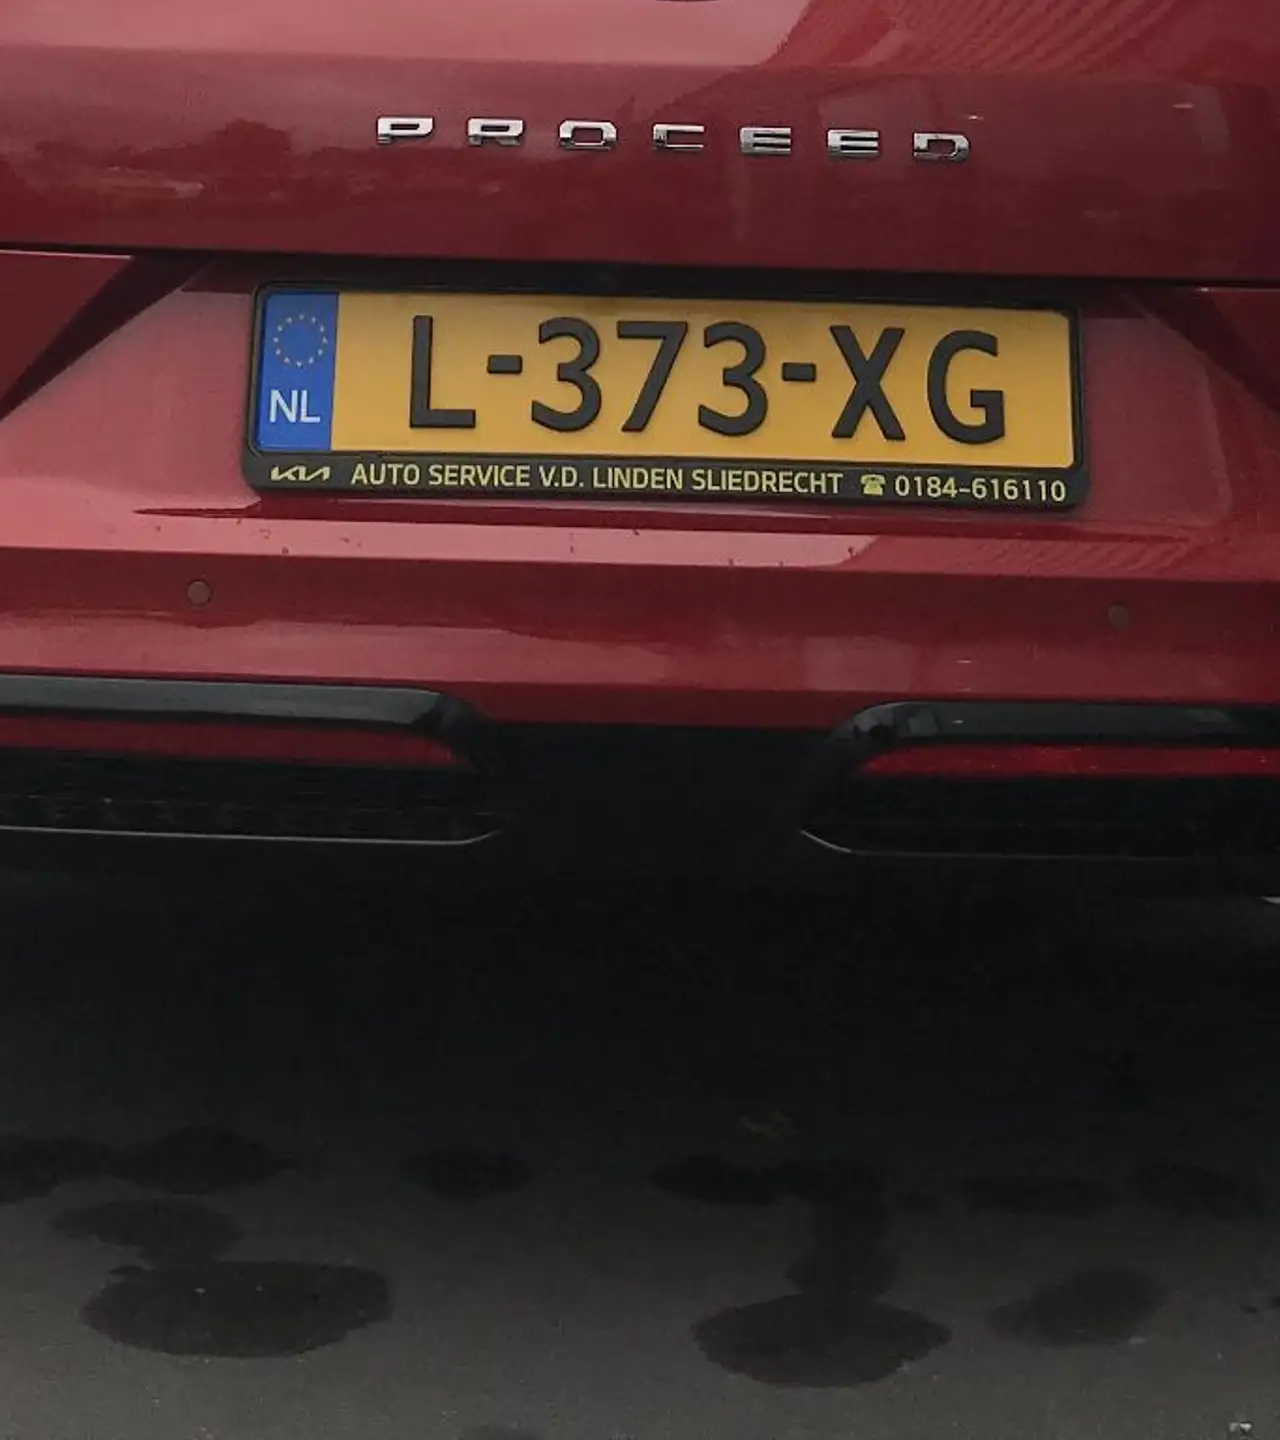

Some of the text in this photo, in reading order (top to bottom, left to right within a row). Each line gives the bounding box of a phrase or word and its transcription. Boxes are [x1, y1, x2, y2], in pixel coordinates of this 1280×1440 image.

[375, 115, 973, 164] PROCEED
[408, 315, 1007, 445] L-373-XG
[268, 389, 322, 426] NL
[351, 462, 1066, 503] AUTO SERVICE V.D. LINDEN SLIEDRECHT 0184-616110
